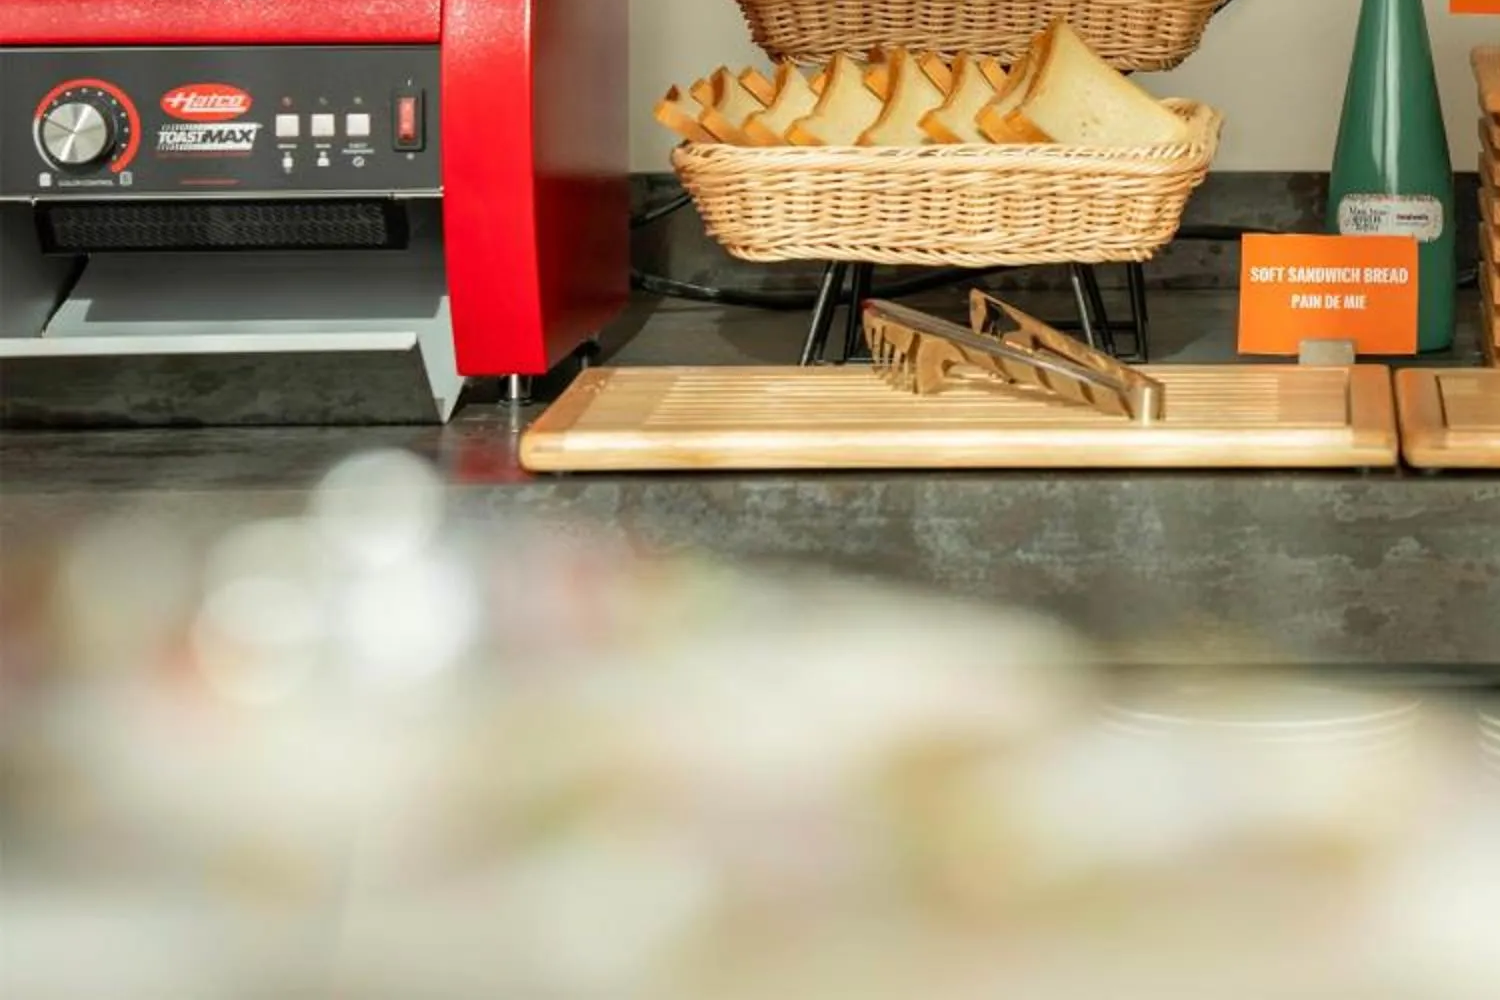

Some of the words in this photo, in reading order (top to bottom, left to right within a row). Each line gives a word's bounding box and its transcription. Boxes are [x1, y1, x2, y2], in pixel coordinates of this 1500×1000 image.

[163, 92, 247, 113] Hatco
[1250, 265, 1286, 283] SOFT
[1288, 266, 1361, 284] SANDWICH
[1363, 266, 1409, 284] BREAD
[1291, 294, 1322, 310] PAIN
[1325, 294, 1341, 310] DE
[1344, 294, 1368, 310] MIE
